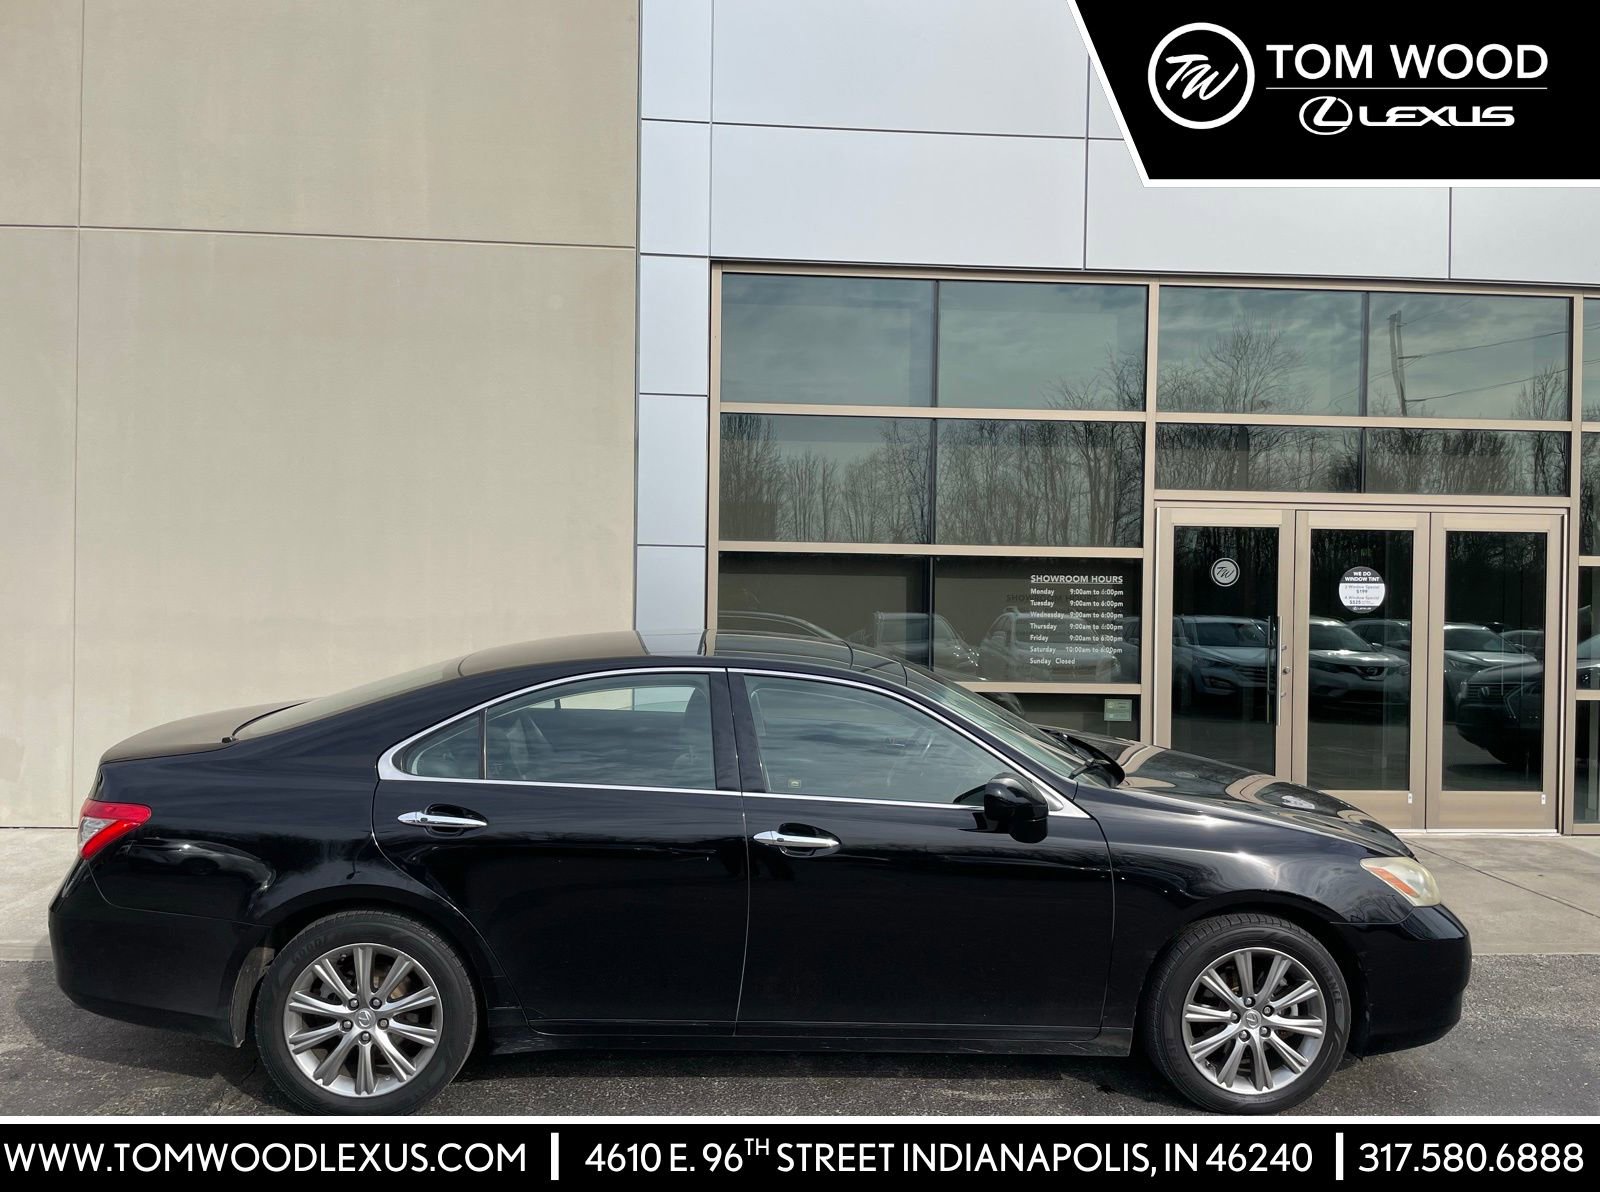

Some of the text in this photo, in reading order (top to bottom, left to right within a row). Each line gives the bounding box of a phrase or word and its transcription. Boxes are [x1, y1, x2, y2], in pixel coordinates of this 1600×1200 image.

[1030, 574, 1124, 584] SHOWROOM HOURS
[1030, 588, 1055, 597] Monday
[1069, 588, 1092, 596] 9:00am
[1101, 588, 1124, 597] 6:00pm
[1030, 599, 1055, 609] Tuesday
[1069, 600, 1092, 608] 9:00am
[1101, 600, 1124, 609] 6:00pm
[1029, 611, 1065, 620] Wednesday
[1069, 611, 1092, 619] 9:00am
[1101, 611, 1124, 620] 6:00pm
[1029, 622, 1058, 632] Thursday
[1069, 623, 1092, 631] 9:00am
[1101, 623, 1124, 632] 6:00pm
[1029, 634, 1049, 643] Friday
[1069, 634, 1092, 642] 9:00am
[1101, 634, 1124, 643] 6:00pm
[1029, 645, 1123, 655] Saturday 10:00am to 6:00pm
[1029, 657, 1076, 666] Sunday Closed
